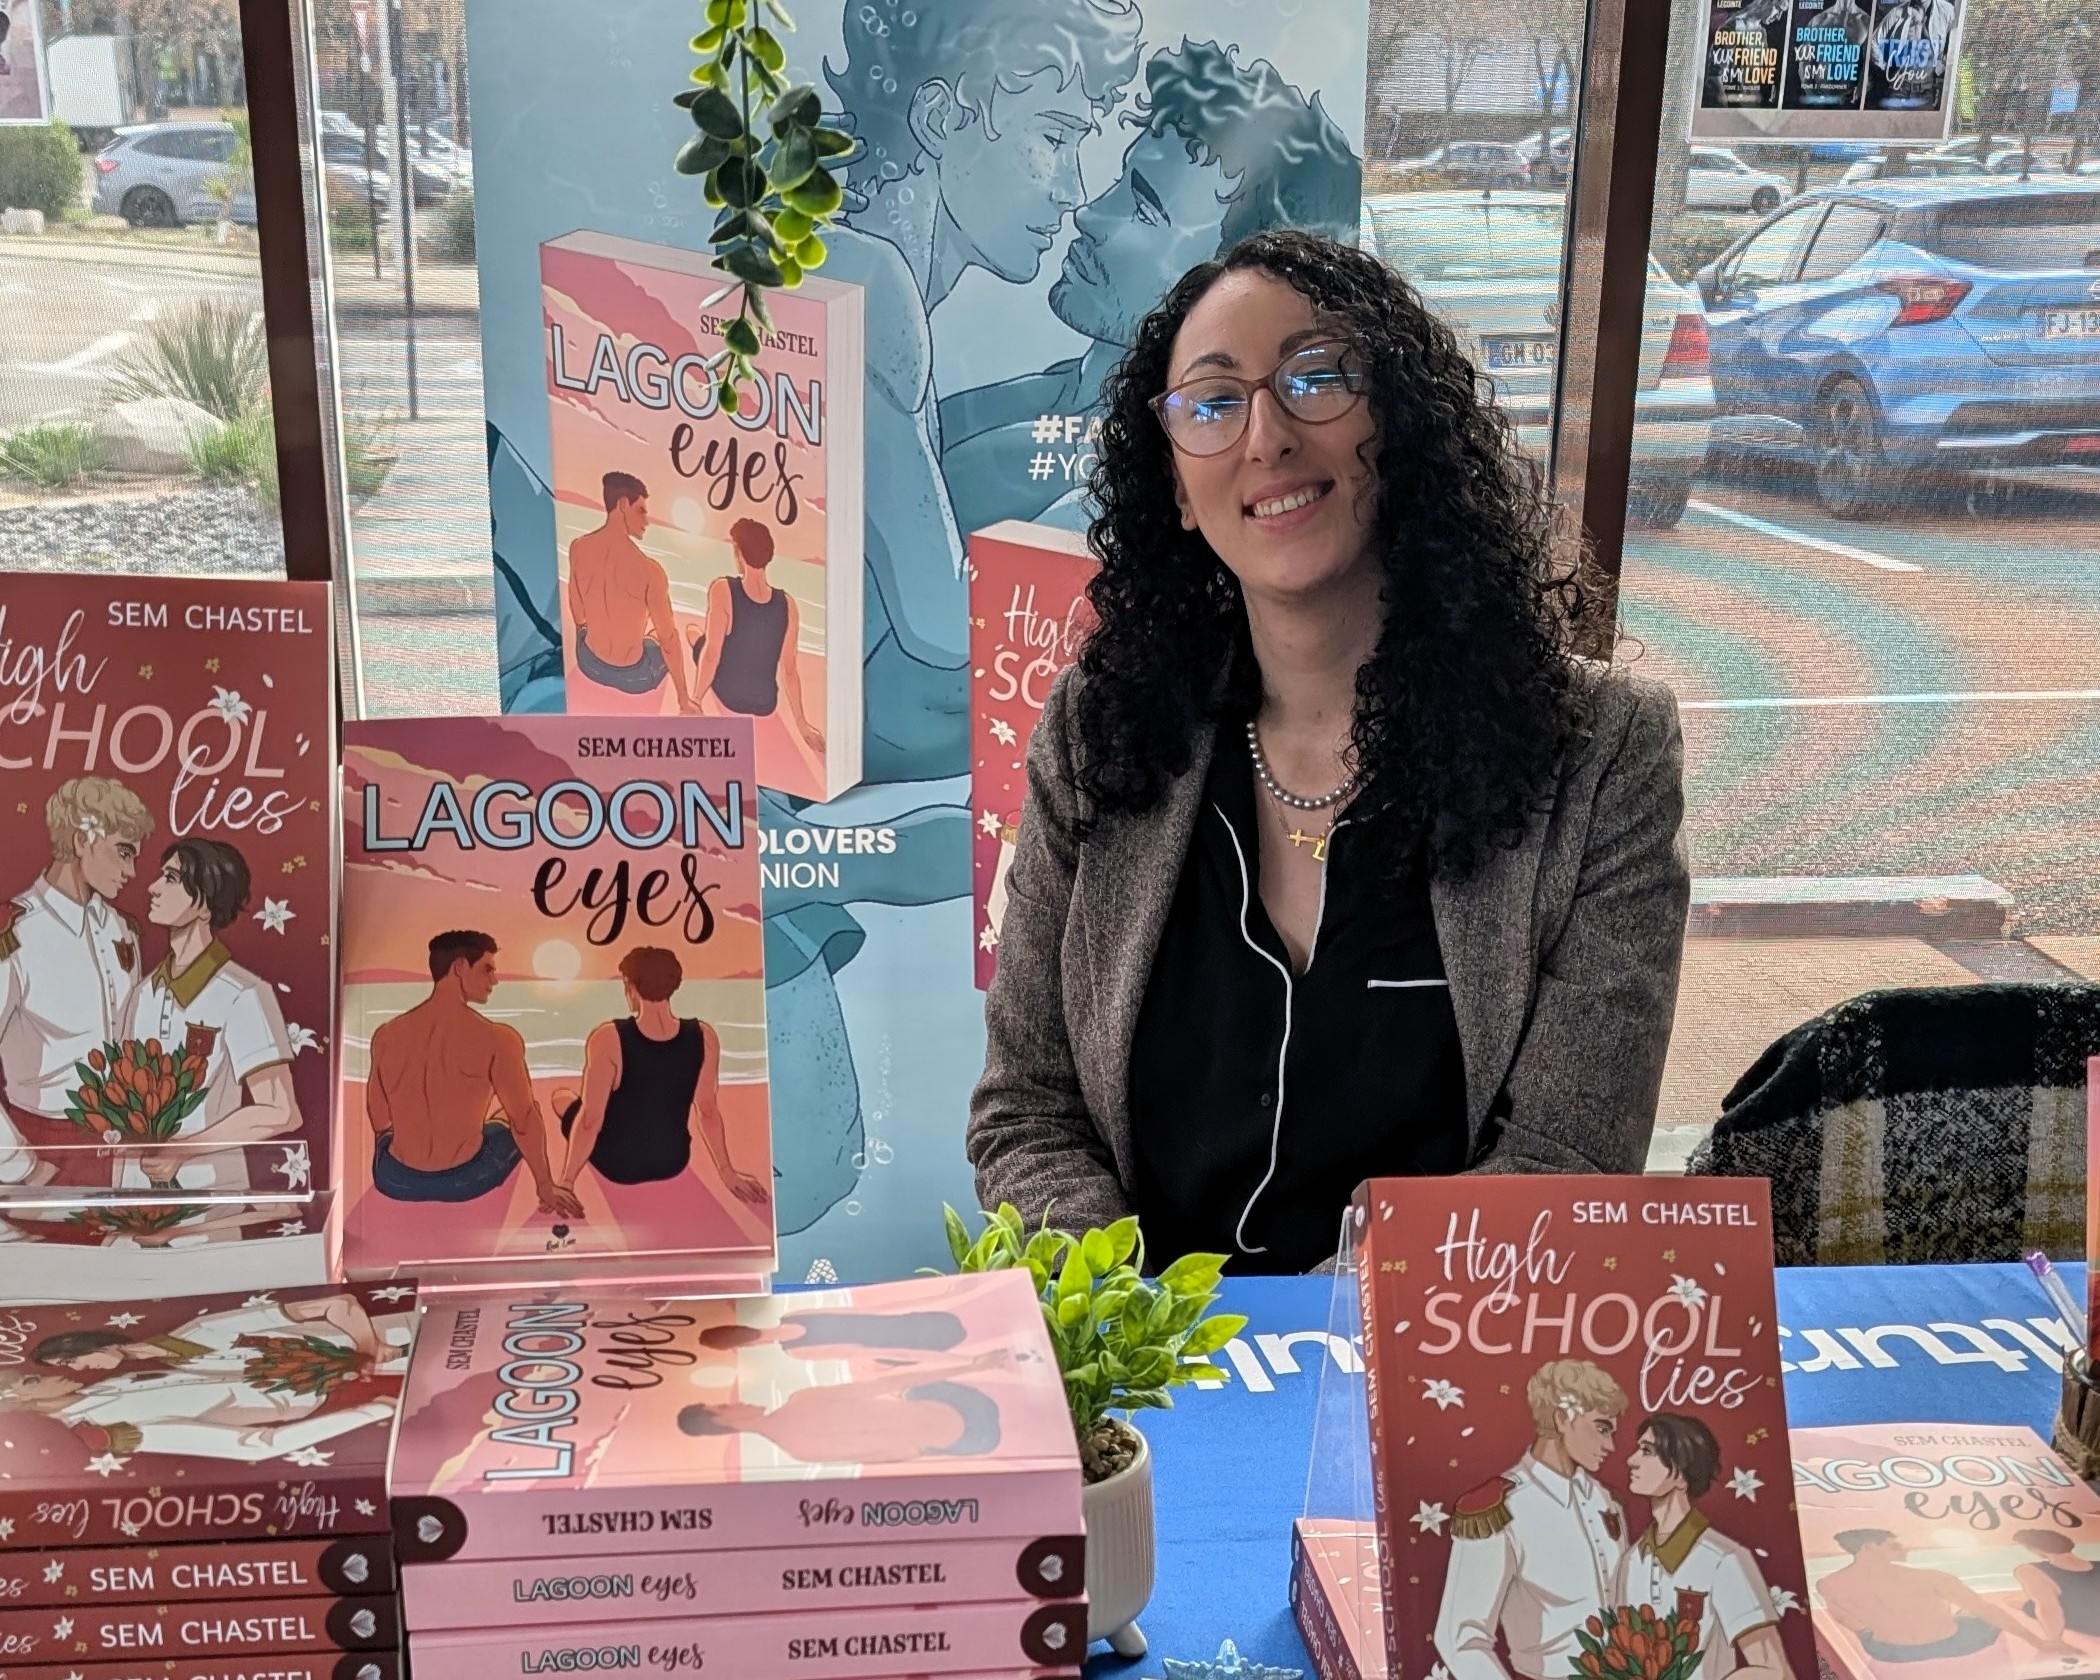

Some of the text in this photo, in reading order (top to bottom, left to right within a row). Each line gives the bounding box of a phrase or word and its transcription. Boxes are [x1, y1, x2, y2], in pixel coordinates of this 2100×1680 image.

[1714, 31, 1765, 47] BROTHER,
[1796, 27, 1848, 43] BROTHER,
[1734, 48, 1777, 66] FRIEND
[1816, 45, 1861, 63] FRIEND
[1886, 50, 1928, 91] You
[1745, 67, 1776, 85] LOVE
[1827, 64, 1858, 81] LOVE
[699, 314, 818, 358] SE ASTEL
[551, 323, 823, 447] LAGOON
[668, 423, 804, 527] eyes
[107, 601, 313, 634] SEM CHASTEL
[577, 737, 736, 759] SEM CHASTEL
[169, 744, 308, 837] lies
[362, 779, 745, 853] LAGOON
[530, 853, 722, 947] eyes
[1572, 1201, 1758, 1227] SEM CHASTEL
[1434, 1207, 1577, 1315] High
[446, 1307, 482, 1371] SEM CHASTEL
[1359, 1250, 1379, 1420] SEM CHASTEL
[1417, 1291, 1743, 1358] SCHOOL
[591, 1311, 698, 1391] eyes
[1639, 1327, 1764, 1413] lies
[483, 1302, 590, 1482] LAGOON
[1894, 1434, 2033, 1449] SEM CHASTEL
[28, 1481, 341, 1539] High SCHOOL lies
[541, 1507, 714, 1536] SEM CHASTEL
[798, 1498, 979, 1527] LAGOON eyes
[1903, 1487, 2084, 1532] eyes
[89, 1560, 309, 1592] SEM CHASTEL
[513, 1571, 699, 1602] LAGOON eyes
[781, 1562, 947, 1591] SEM CHASTEL
[1376, 1520, 1398, 1654] SCHOOL
[0, 1631, 41, 1655] es
[99, 1616, 316, 1649] SEM CHASTEL
[787, 1630, 952, 1660] SEM CHASTEL
[521, 1642, 706, 1674] LAGOON eyes
